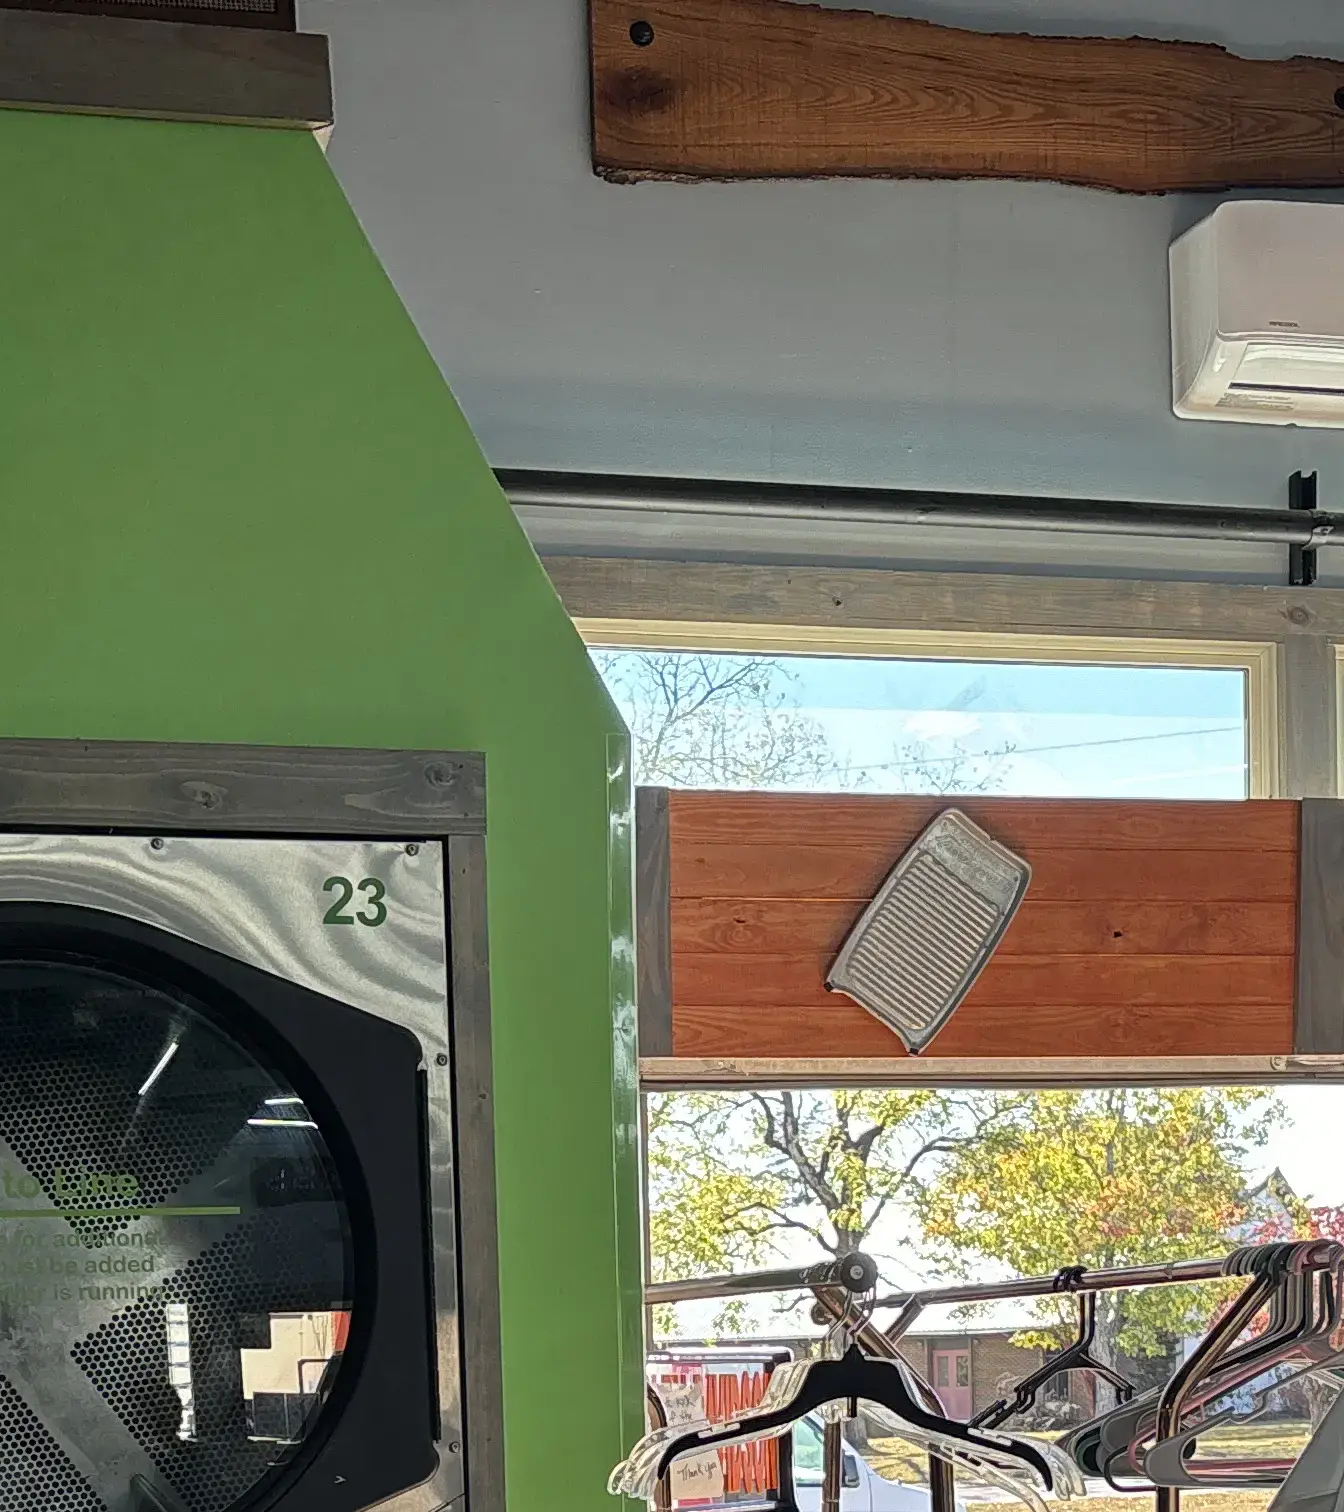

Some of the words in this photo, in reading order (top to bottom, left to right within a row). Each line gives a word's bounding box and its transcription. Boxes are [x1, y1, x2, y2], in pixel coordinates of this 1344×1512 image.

[322, 876, 387, 927] 23
[3, 1170, 41, 1199] to
[85, 1254, 155, 1274] added
[78, 1283, 164, 1305] running
